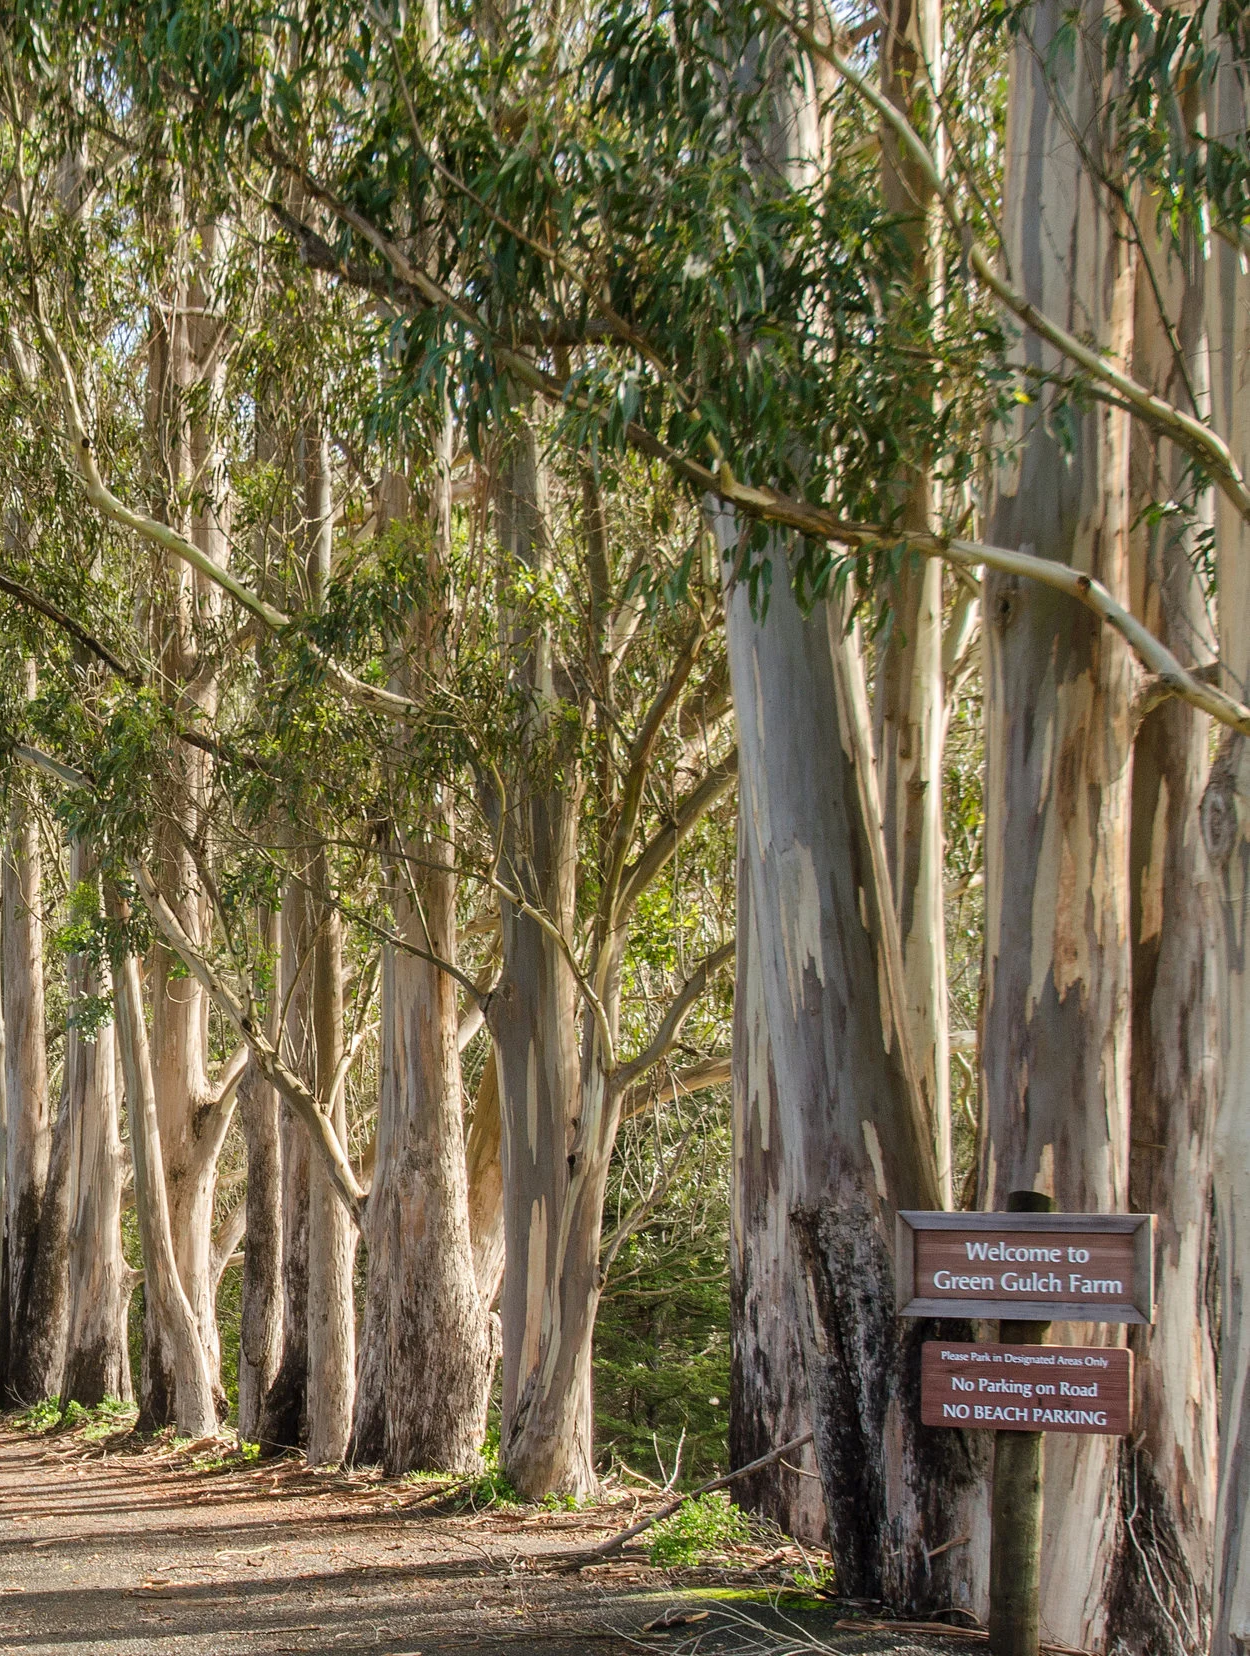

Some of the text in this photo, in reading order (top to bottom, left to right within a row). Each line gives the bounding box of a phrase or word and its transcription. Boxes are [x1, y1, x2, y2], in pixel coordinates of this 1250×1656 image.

[965, 1242, 1090, 1264] Welcome to
[933, 1270, 1123, 1294] Green Gulch Farm
[941, 1350, 1108, 1369] Please Park in Designated Areas Only
[951, 1377, 1098, 1398] No Parking on Road
[943, 1404, 1107, 1426] NO BEACH PARKING
